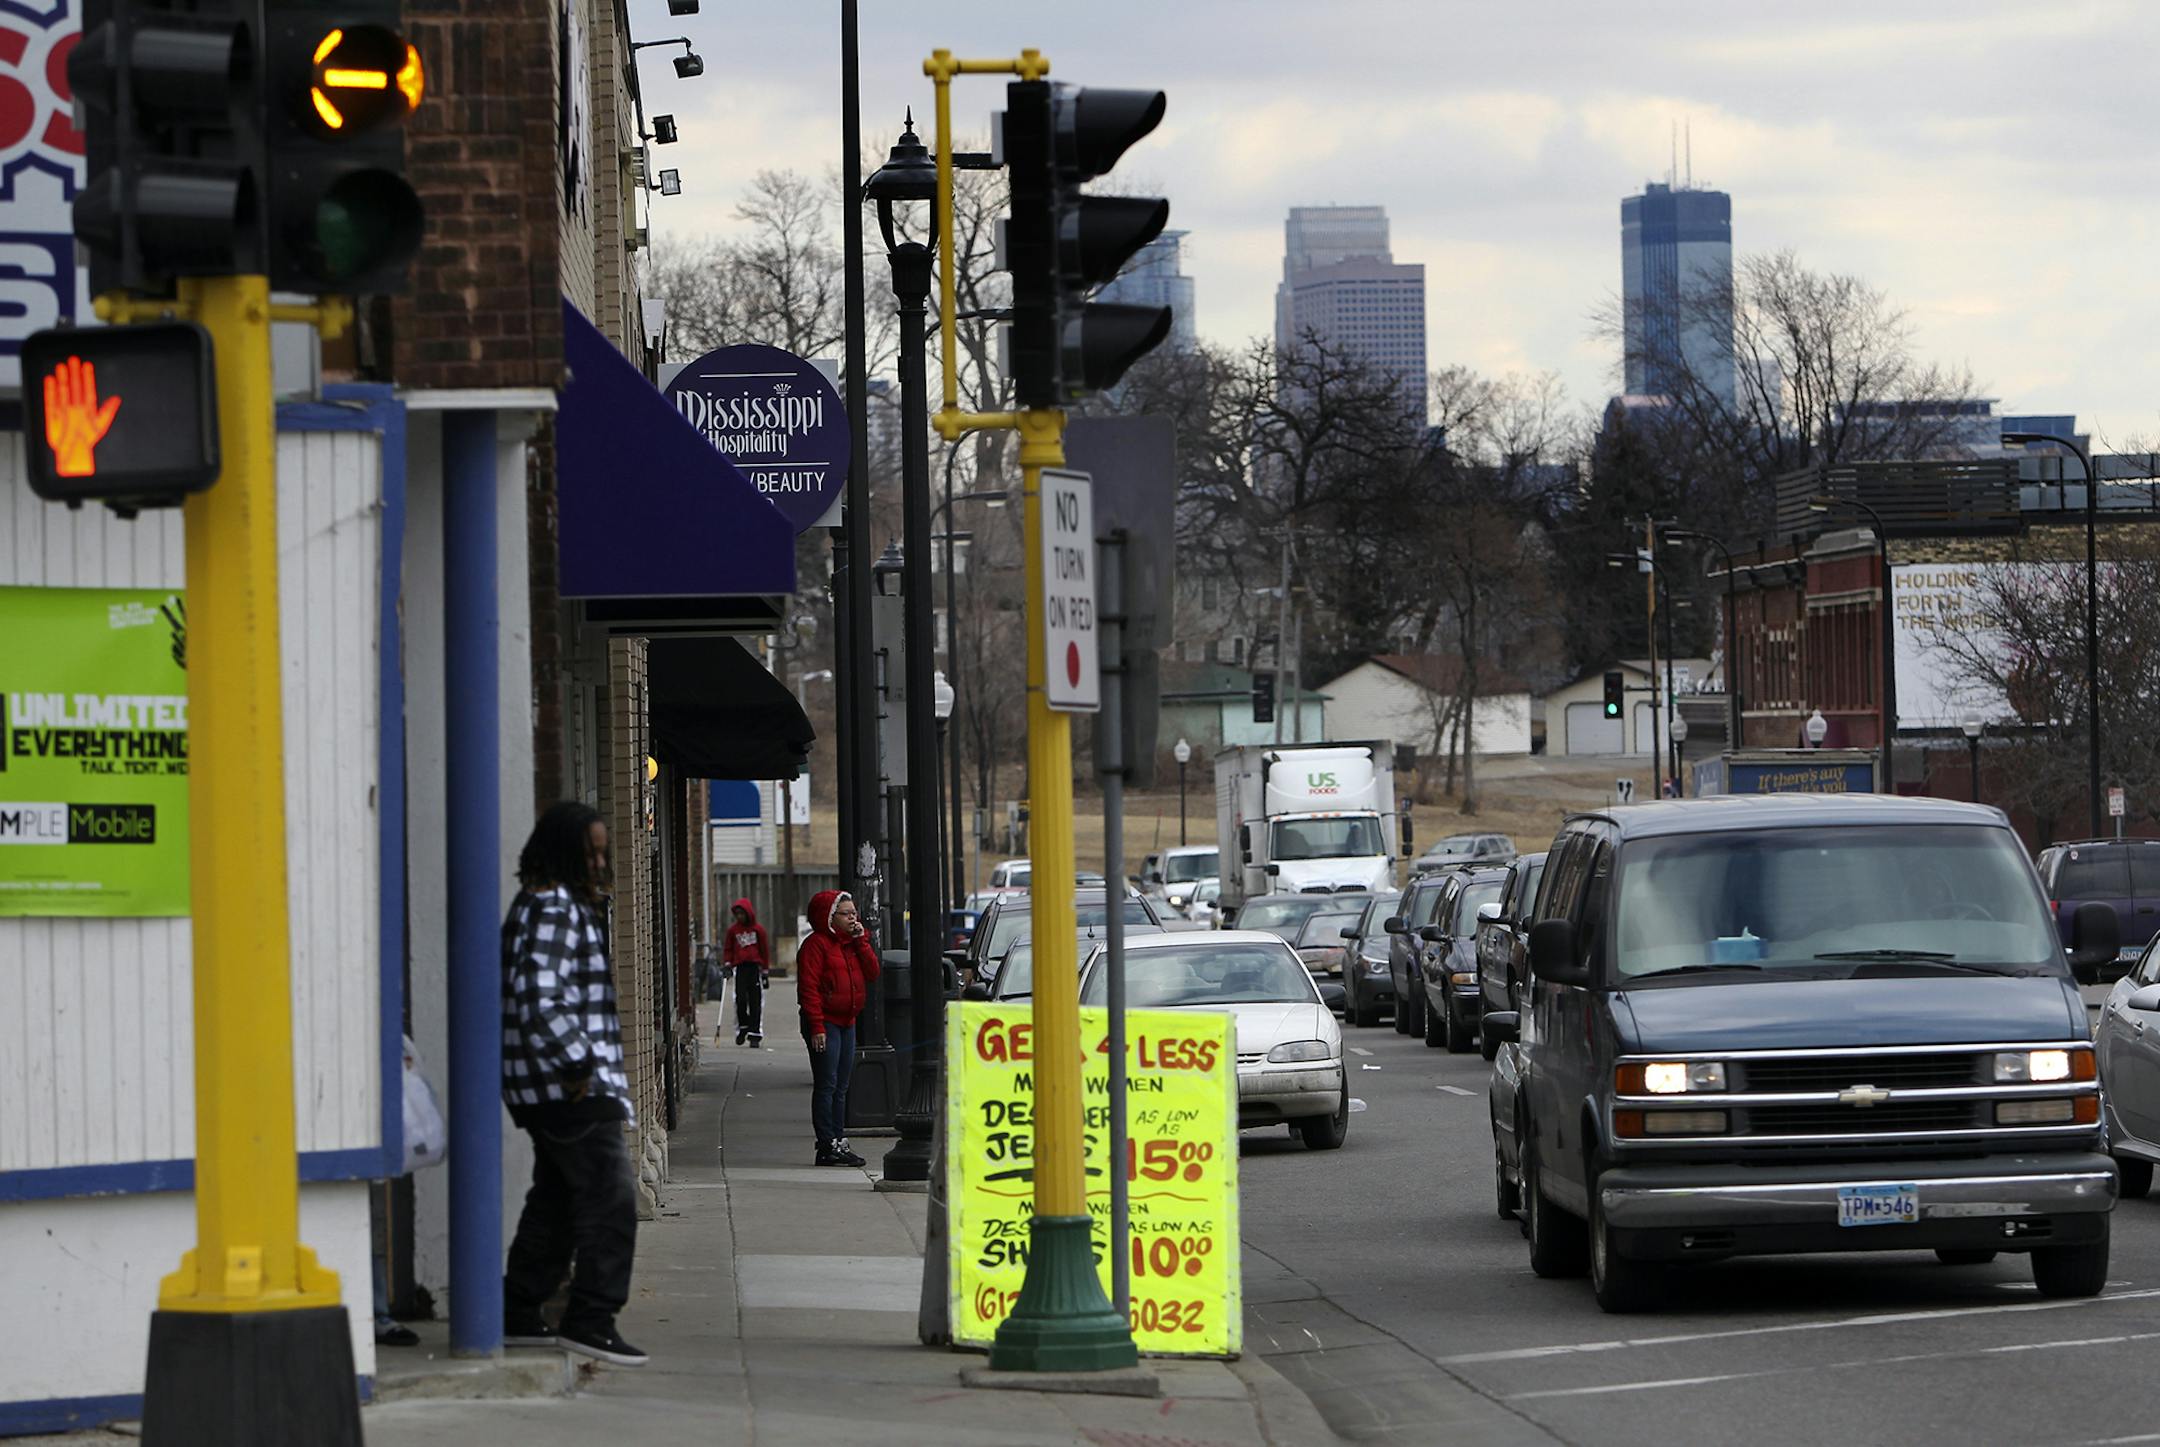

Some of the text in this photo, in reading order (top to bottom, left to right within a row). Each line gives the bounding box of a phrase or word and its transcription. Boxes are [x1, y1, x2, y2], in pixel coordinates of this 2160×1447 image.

[676, 388, 824, 437] Mississippi
[702, 428, 788, 458] Hospitality
[1056, 491, 1079, 533] NO
[1054, 546, 1085, 581] TURN
[1895, 573, 1977, 588] HOLDING
[1049, 597, 1092, 631] ON RED
[1897, 594, 1963, 610] FORTH
[1897, 615, 1936, 631] THE
[70, 808, 152, 838] Mobile
[1138, 1035, 1220, 1072] LESS
[980, 1100, 1109, 1128] DEER
[1136, 1109, 1199, 1125] AS LOW
[1157, 1123, 1180, 1136] AS
[986, 1132, 1098, 1160] JES
[1087, 1202, 1149, 1215] WOEN
[1843, 1196, 1914, 1216] TPM 546
[1128, 1221, 1147, 1234] AS
[1152, 1222, 1182, 1232] LOW
[1187, 1220, 1213, 1233] AS
